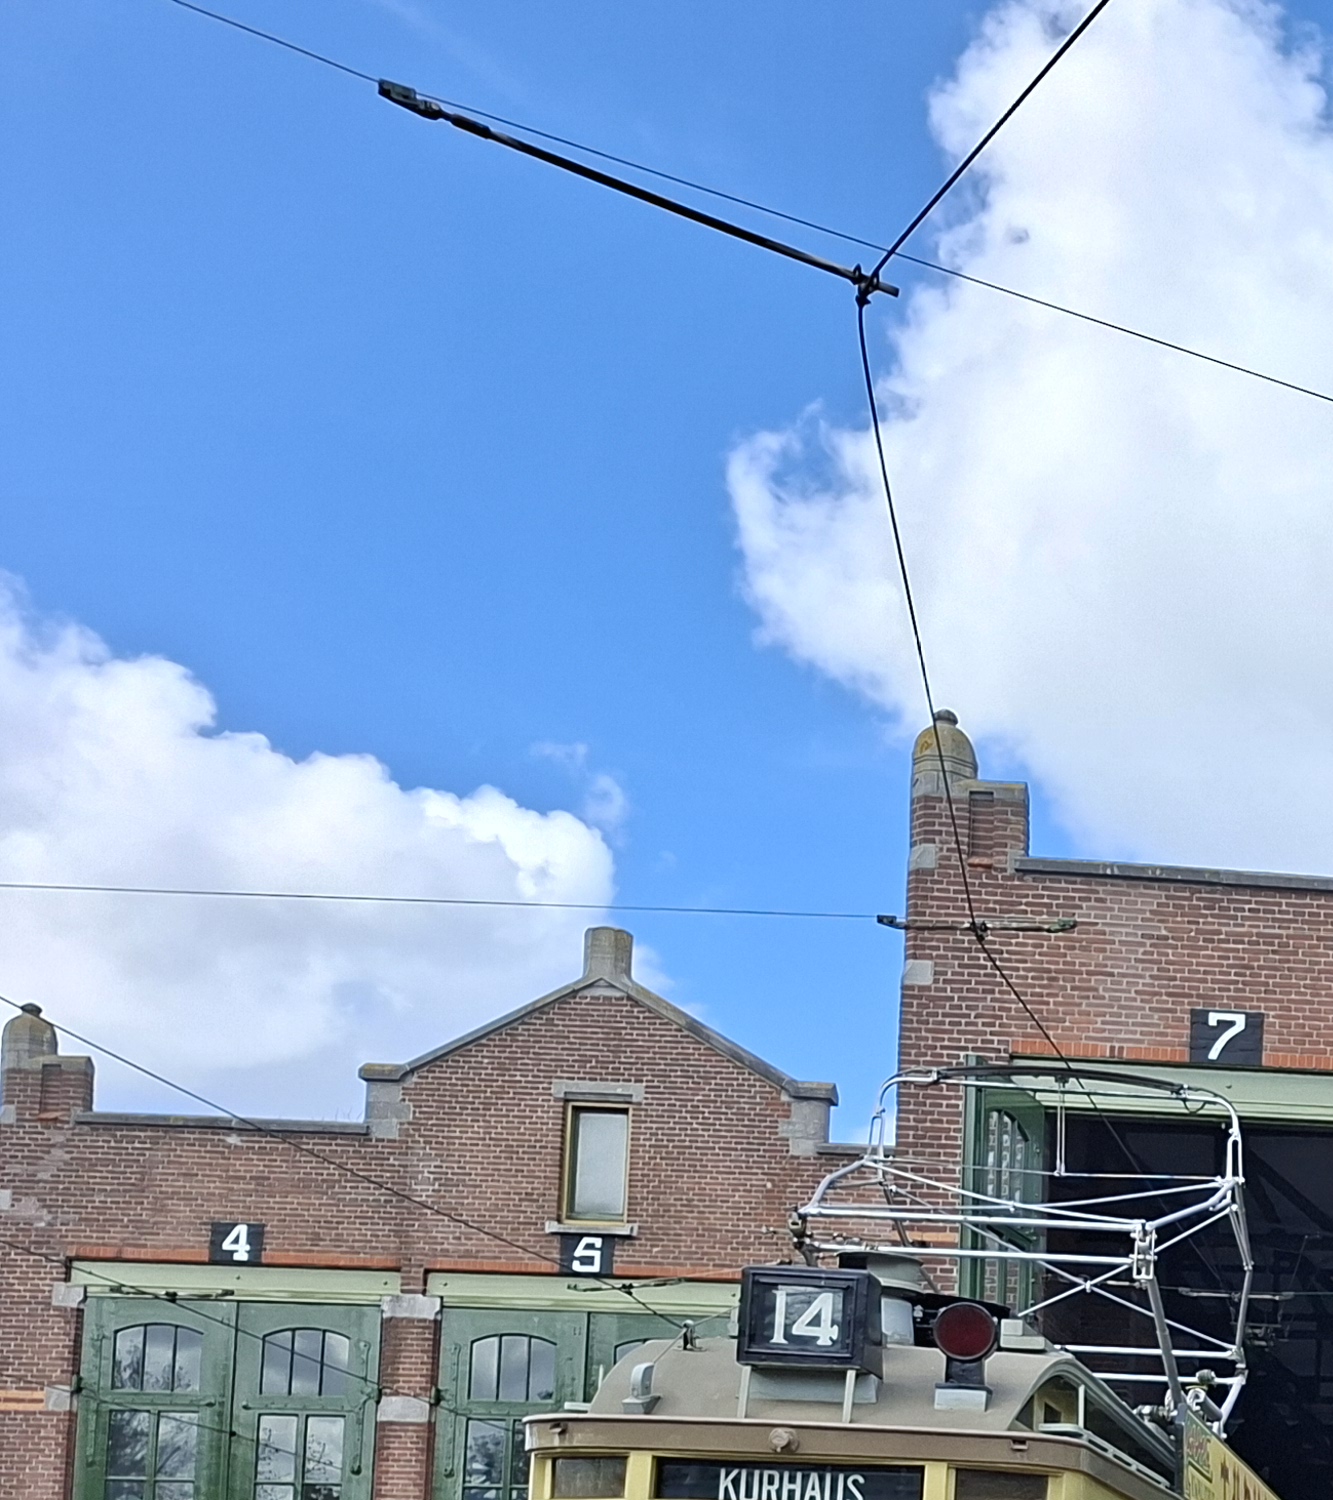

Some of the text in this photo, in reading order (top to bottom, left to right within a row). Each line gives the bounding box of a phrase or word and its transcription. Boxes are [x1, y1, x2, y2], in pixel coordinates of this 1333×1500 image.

[1208, 1011, 1246, 1060] 7
[221, 1223, 251, 1262] 4
[572, 1236, 604, 1274] 5
[769, 1288, 839, 1346] 14
